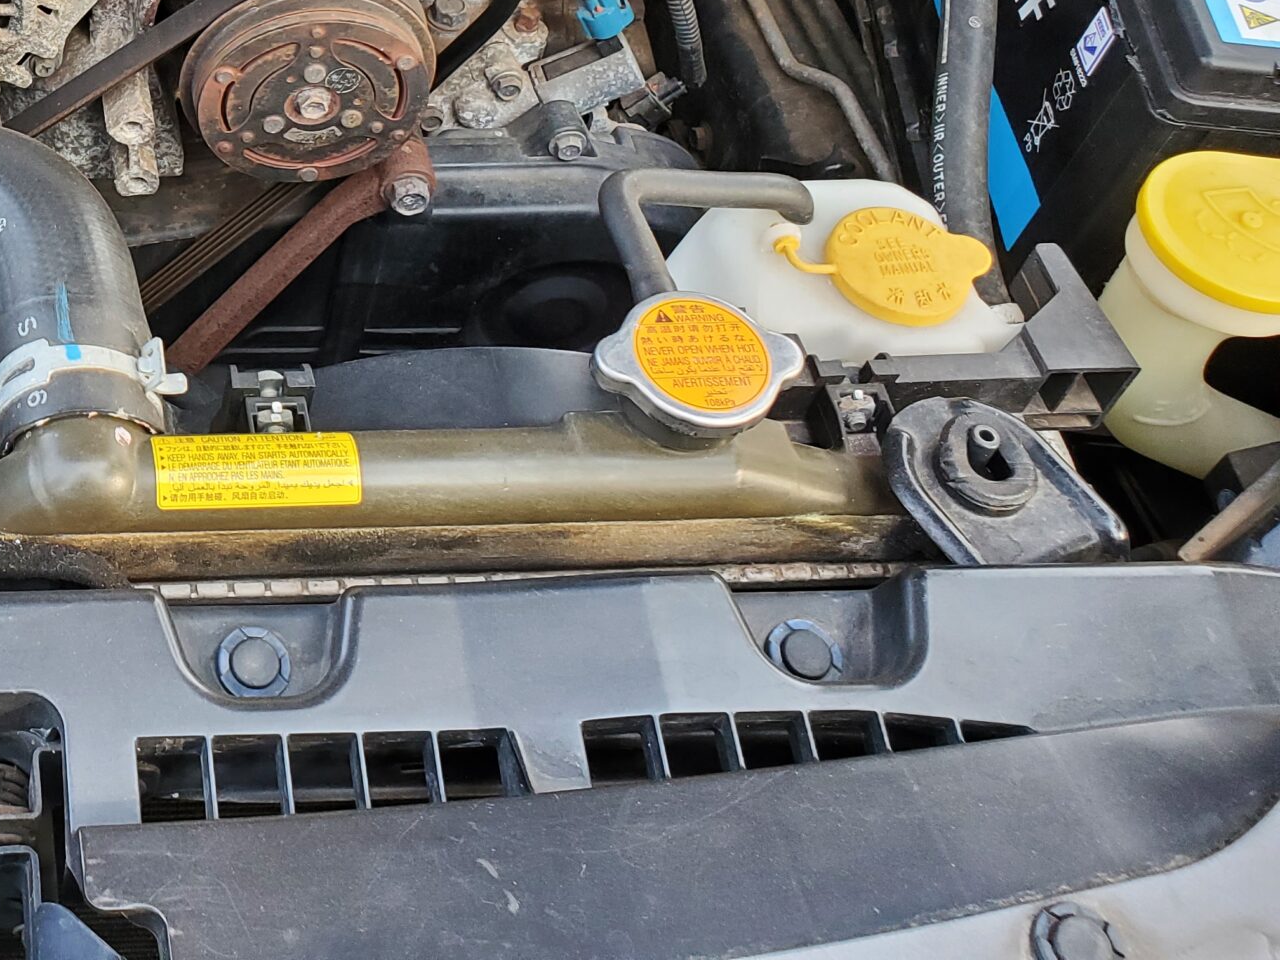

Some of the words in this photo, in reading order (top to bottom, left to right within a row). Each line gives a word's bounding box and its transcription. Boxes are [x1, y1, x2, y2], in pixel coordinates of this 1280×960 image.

[837, 208, 942, 246] COOLANT
[671, 304, 705, 313] 警告
[675, 314, 725, 322] WARNING
[644, 346, 675, 356] NEVER
[677, 345, 703, 355] OPEN
[705, 344, 734, 354] WHEN
[737, 343, 759, 353] HOT.
[646, 357, 659, 367] NE
[661, 356, 691, 366] JAMAIS
[673, 376, 753, 388] AVERTISSEMENT
[201, 435, 241, 443] CAUTION
[247, 434, 304, 442] ATTENTION
[167, 453, 186, 462] KEEP
[188, 452, 214, 461] HANDS
[217, 452, 239, 461] AWAY.
[242, 451, 256, 460] FAN
[259, 451, 286, 459] STARTS
[168, 462, 177, 471] LE
[223, 461, 234, 470] DU
[234, 460, 278, 470] VENTILATEUR
[281, 459, 302, 468] ETANT
[189, 471, 230, 481] APPROCHEZ
[231, 470, 245, 480] PAS
[246, 470, 259, 479] LES
[260, 469, 284, 479] MAINS.
